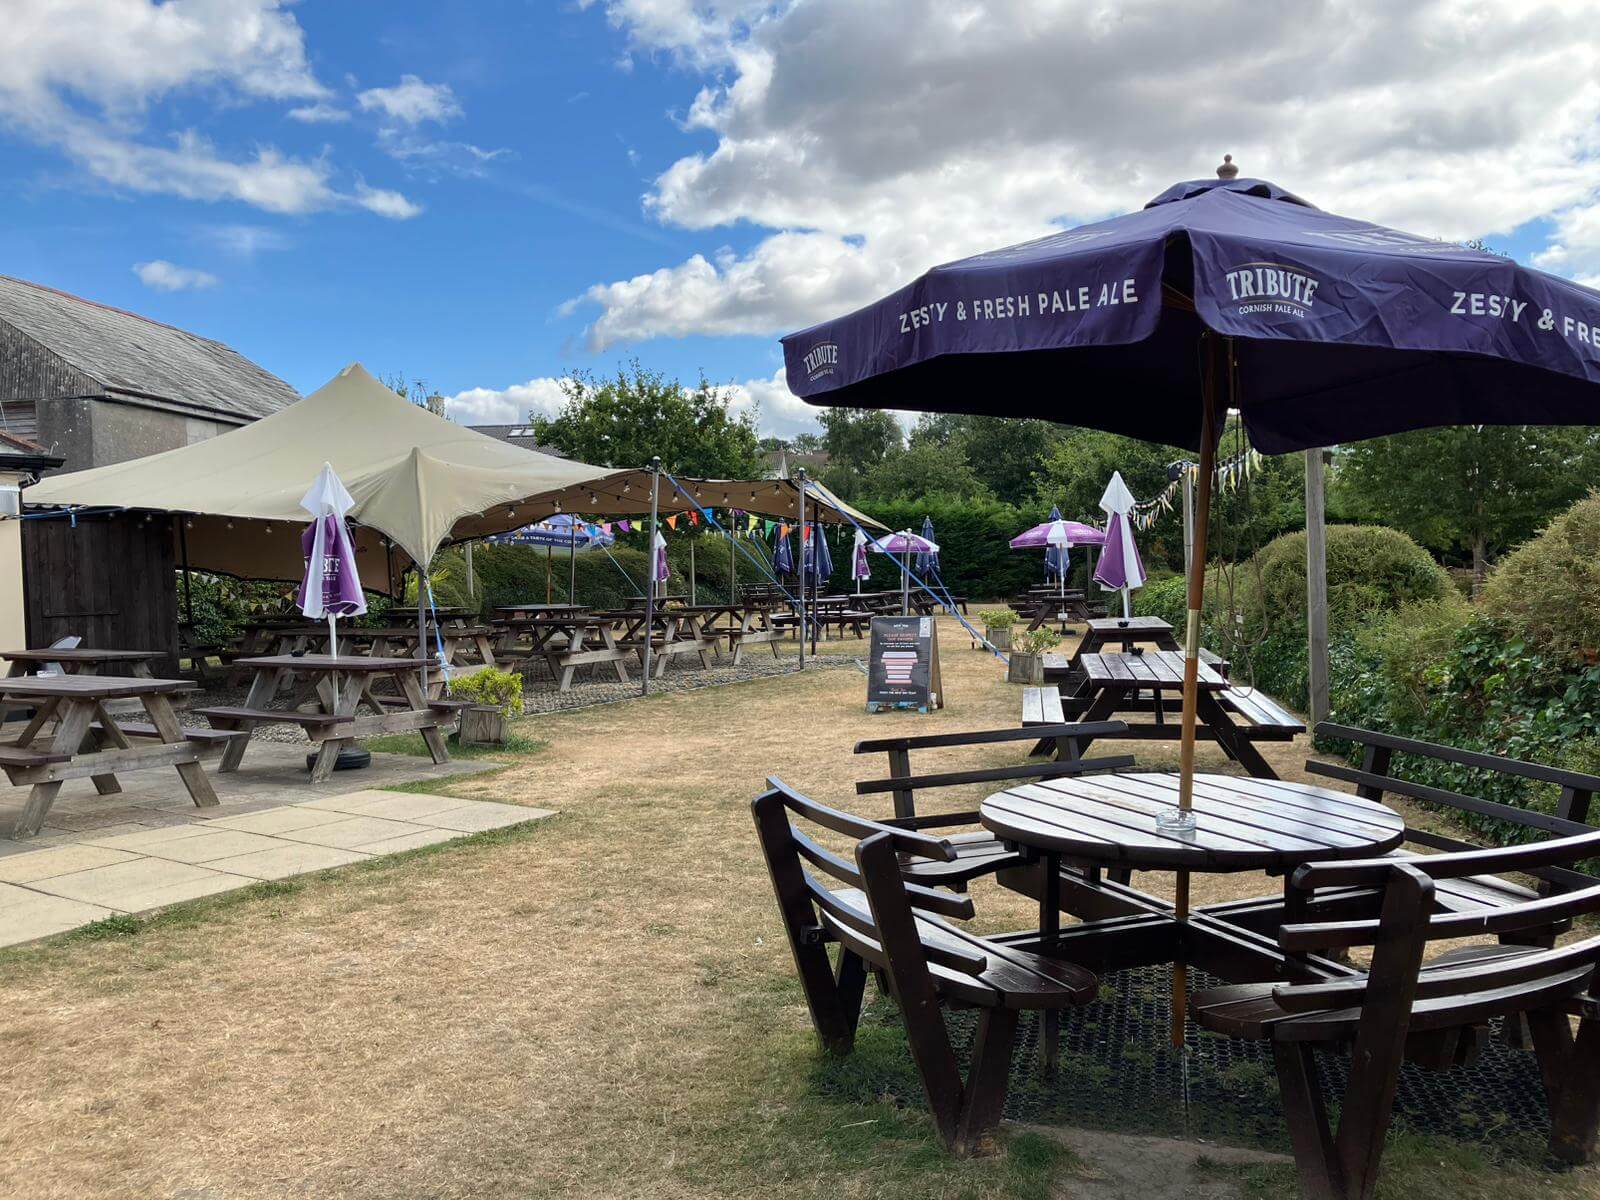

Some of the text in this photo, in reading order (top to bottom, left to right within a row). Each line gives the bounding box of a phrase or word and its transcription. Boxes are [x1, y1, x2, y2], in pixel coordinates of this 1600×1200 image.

[957, 301, 967, 321] &
[974, 295, 1030, 321] FRESH
[1038, 286, 1090, 315] PALE
[1097, 278, 1139, 308] ALE
[1226, 268, 1320, 307] TRIBUTE
[1238, 303, 1305, 318] CORNISH PALE ALE
[1450, 291, 1528, 322] ZESTY
[1537, 308, 1556, 332] &
[803, 344, 838, 375] TRIBUTE
